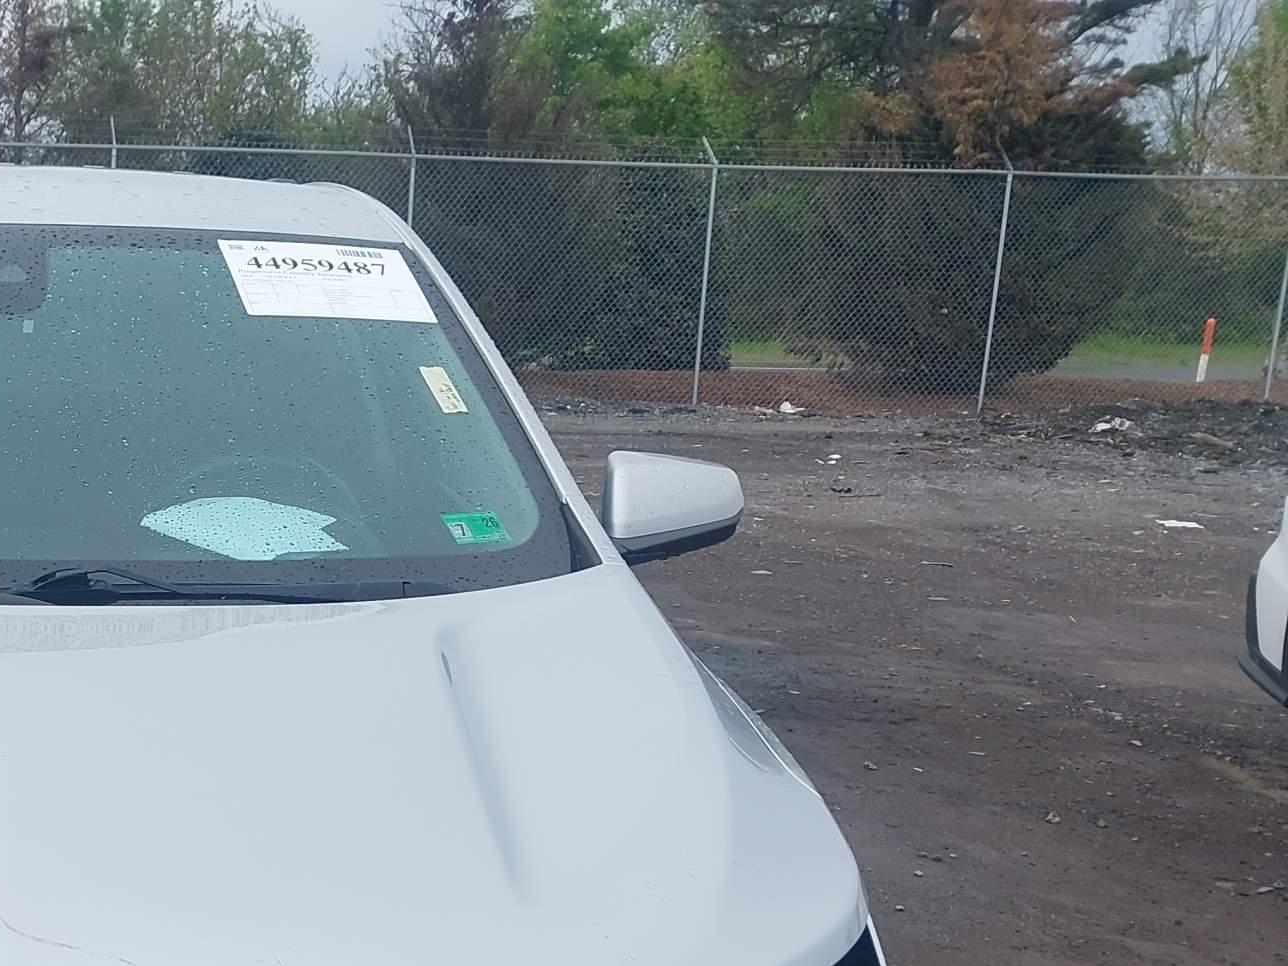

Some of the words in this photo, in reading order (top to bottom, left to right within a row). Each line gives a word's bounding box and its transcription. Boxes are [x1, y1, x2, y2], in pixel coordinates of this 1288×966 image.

[246, 255, 385, 276] 44959487
[450, 523, 467, 537] 7
[481, 516, 500, 528] 26
